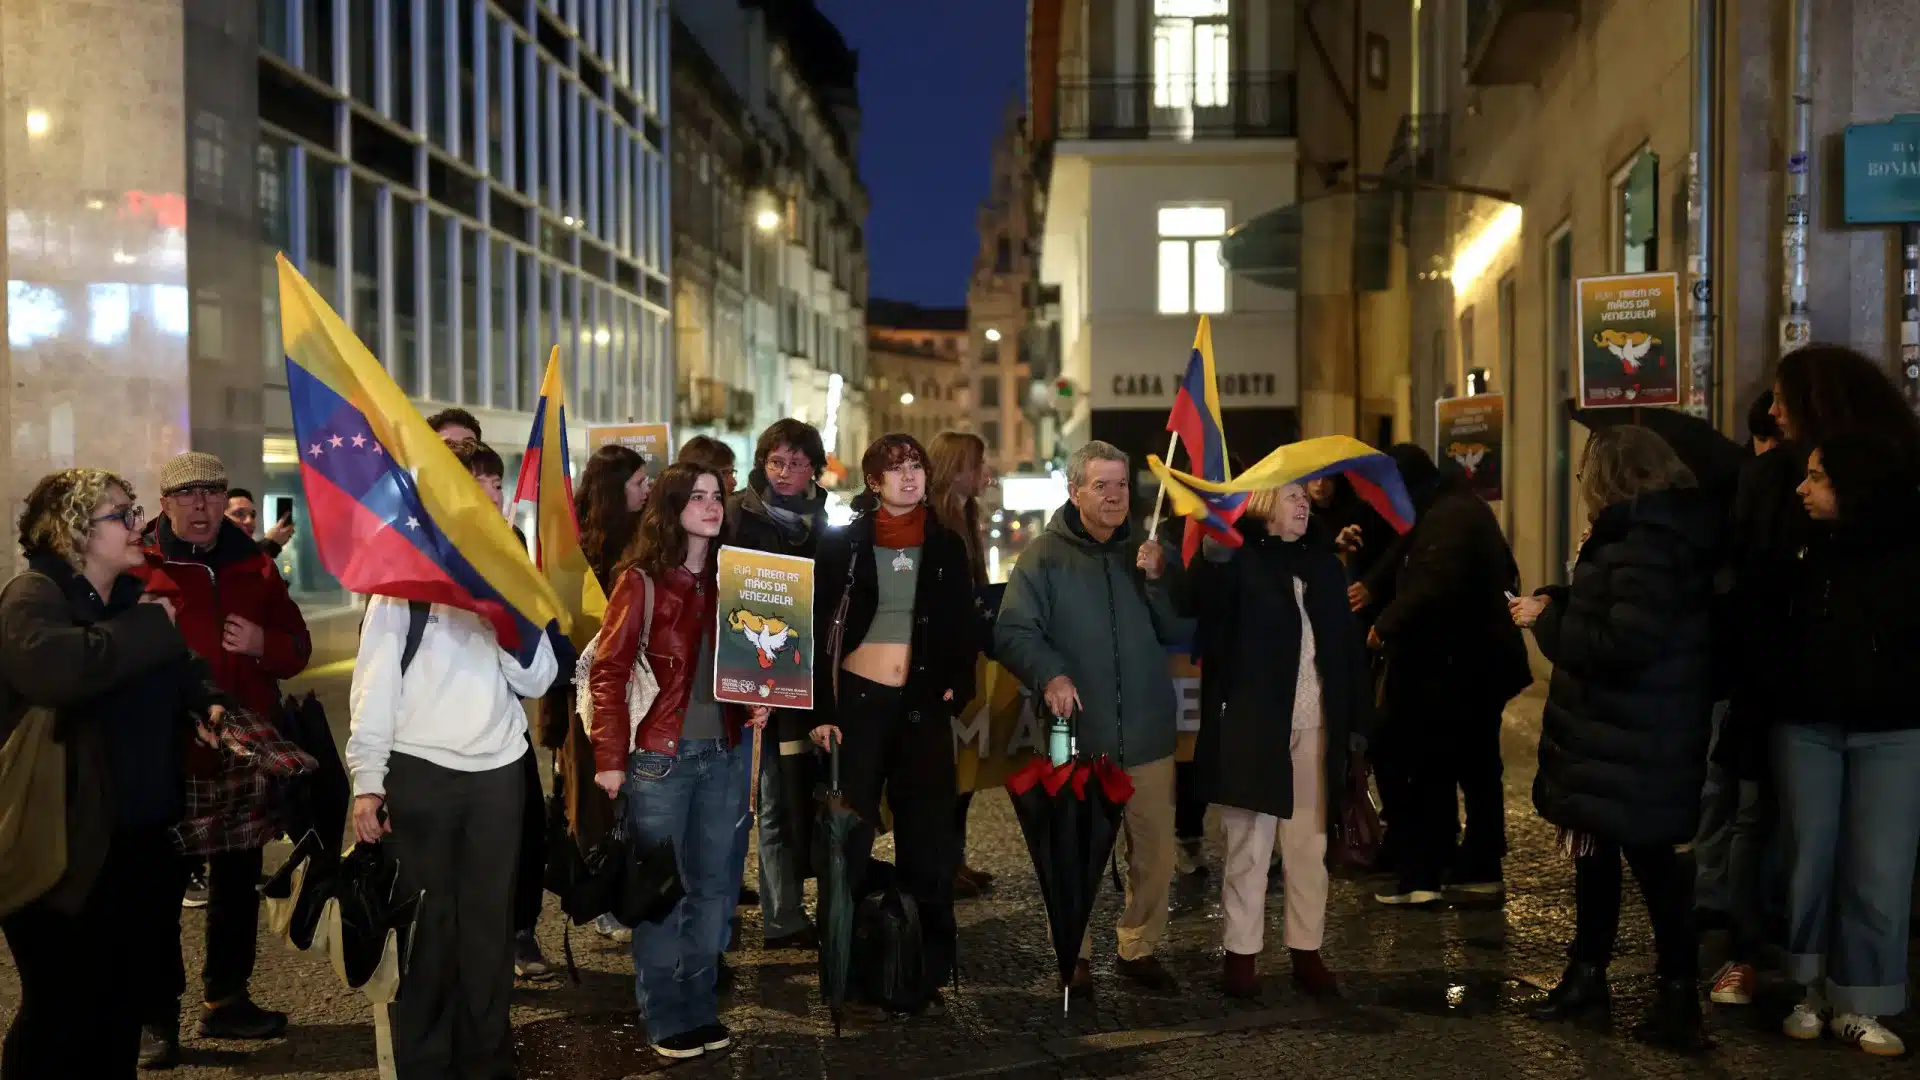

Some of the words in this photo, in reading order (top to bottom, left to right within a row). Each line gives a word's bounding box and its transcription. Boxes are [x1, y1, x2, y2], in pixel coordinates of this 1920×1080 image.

[1867, 161, 1920, 177] BONJA
[1636, 300, 1650, 309] DA
[1600, 309, 1657, 321] VENEZUELA!
[1112, 373, 1164, 396] CASA
[1216, 373, 1276, 396] ORTE
[756, 567, 785, 581] TIREM
[786, 572, 800, 583] AS
[744, 577, 773, 591] MÃOS
[774, 582, 788, 593] DA
[739, 589, 793, 606] VENEZUELA!
